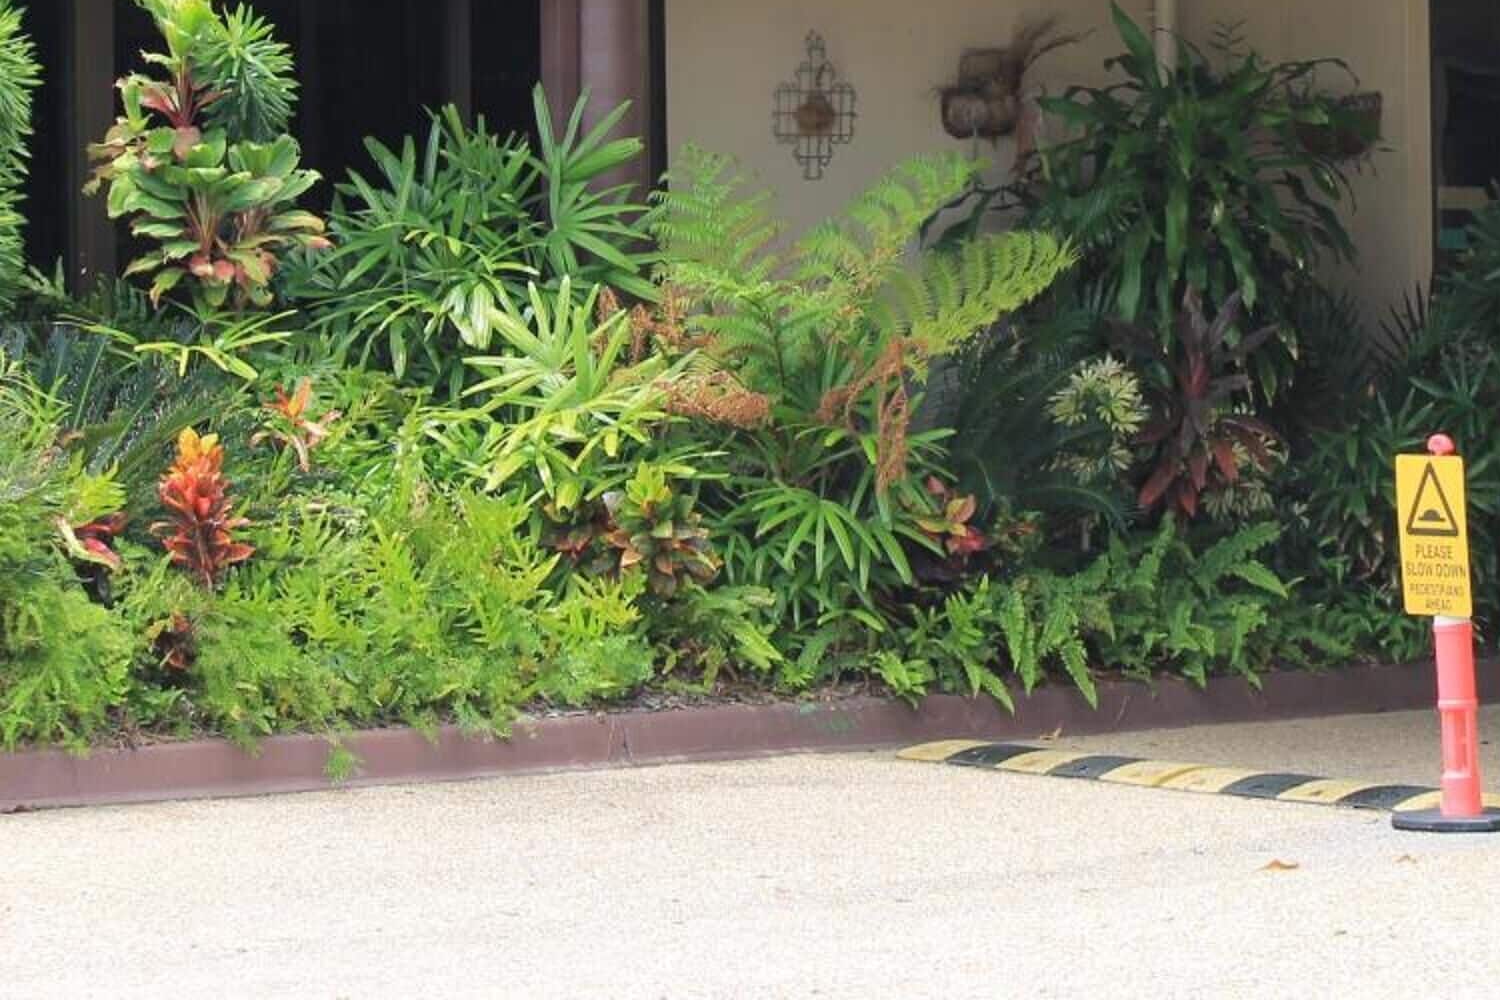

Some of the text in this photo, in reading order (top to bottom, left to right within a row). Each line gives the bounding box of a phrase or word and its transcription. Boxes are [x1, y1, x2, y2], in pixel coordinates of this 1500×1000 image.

[1415, 543, 1454, 560] PLEASE
[1405, 560, 1467, 579] SLOW DOWN
[1425, 598, 1453, 612] AHEAD
